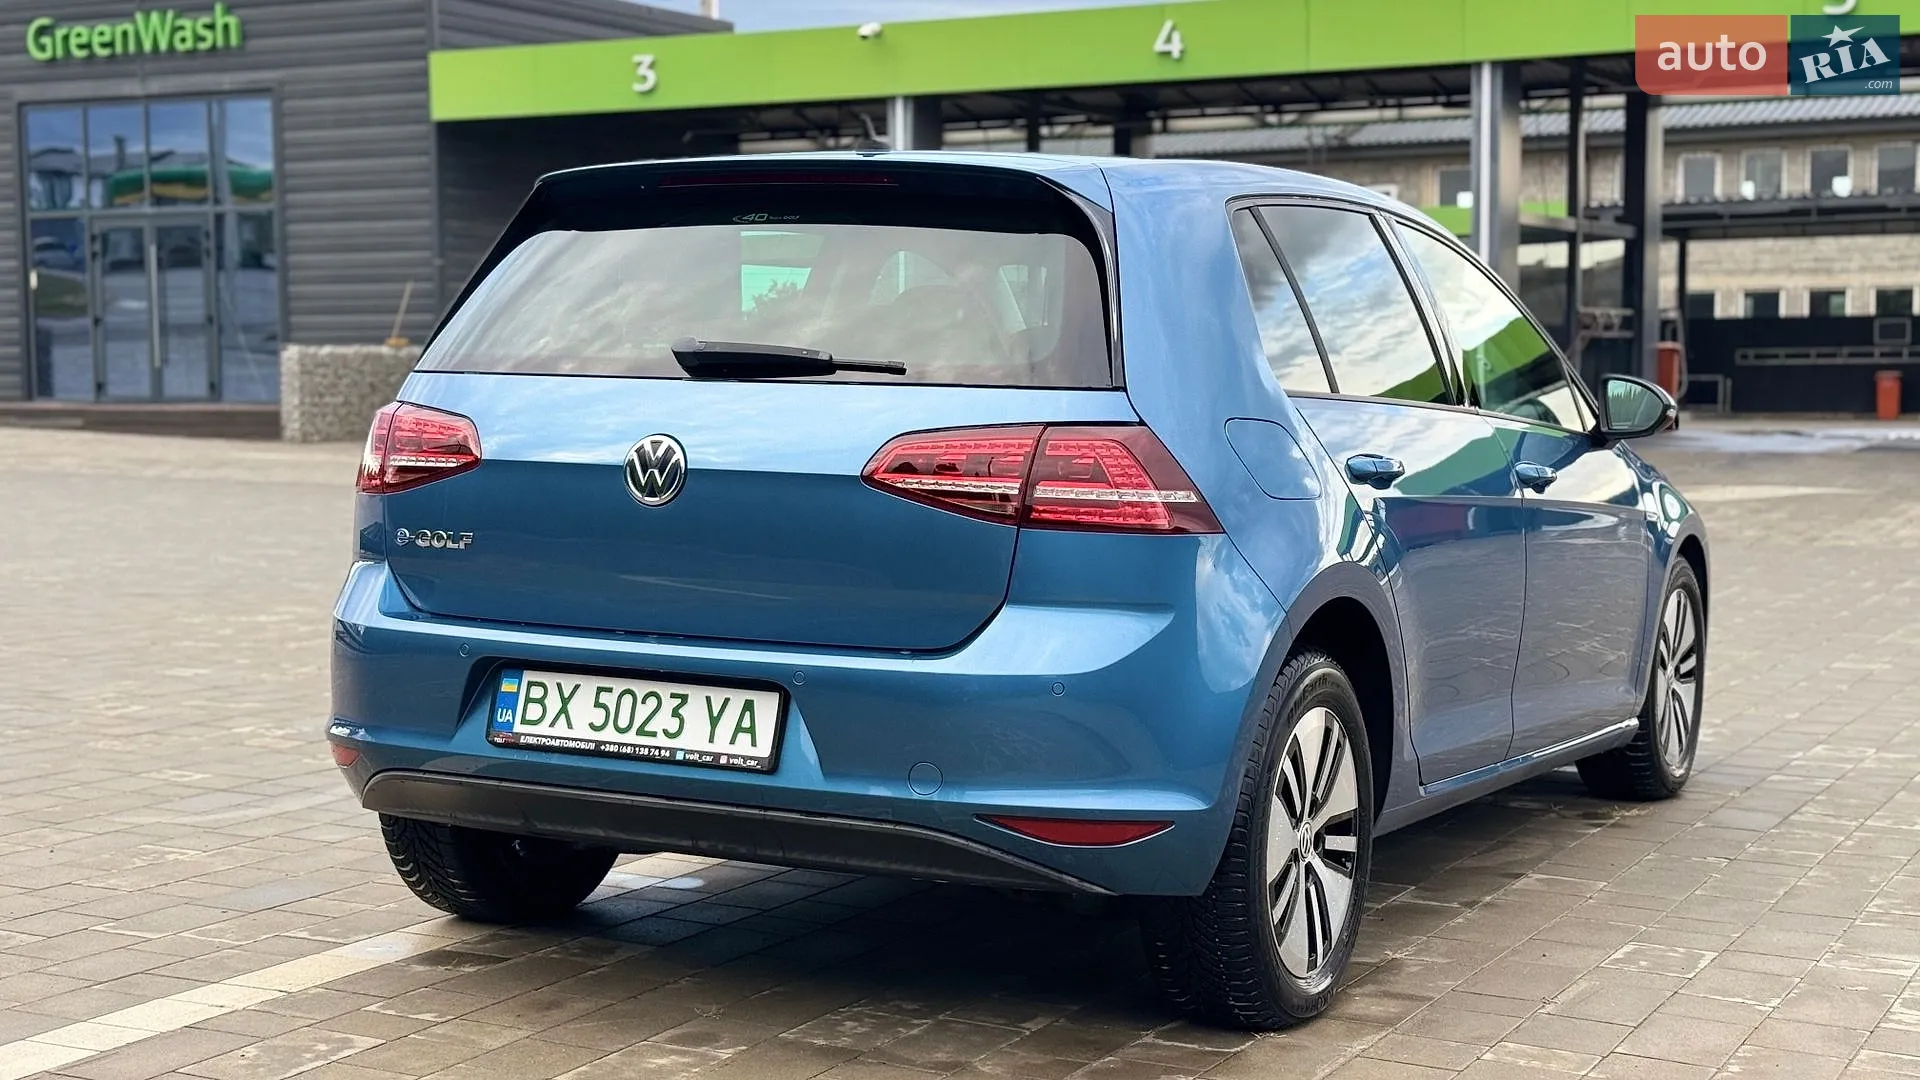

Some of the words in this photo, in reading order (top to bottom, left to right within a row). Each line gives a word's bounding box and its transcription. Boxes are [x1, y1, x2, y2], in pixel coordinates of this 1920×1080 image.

[26, 2, 242, 61] GreenWash
[1153, 19, 1184, 59] 4
[631, 53, 657, 93] 3
[395, 527, 474, 550] e-GOLF
[497, 707, 513, 723] UA
[520, 680, 581, 730] BX
[588, 686, 689, 739] 5023
[705, 695, 758, 748] YA
[600, 744, 618, 753] +380
[635, 747, 649, 755] 138
[649, 748, 660, 757] 74
[660, 750, 671, 758] 94
